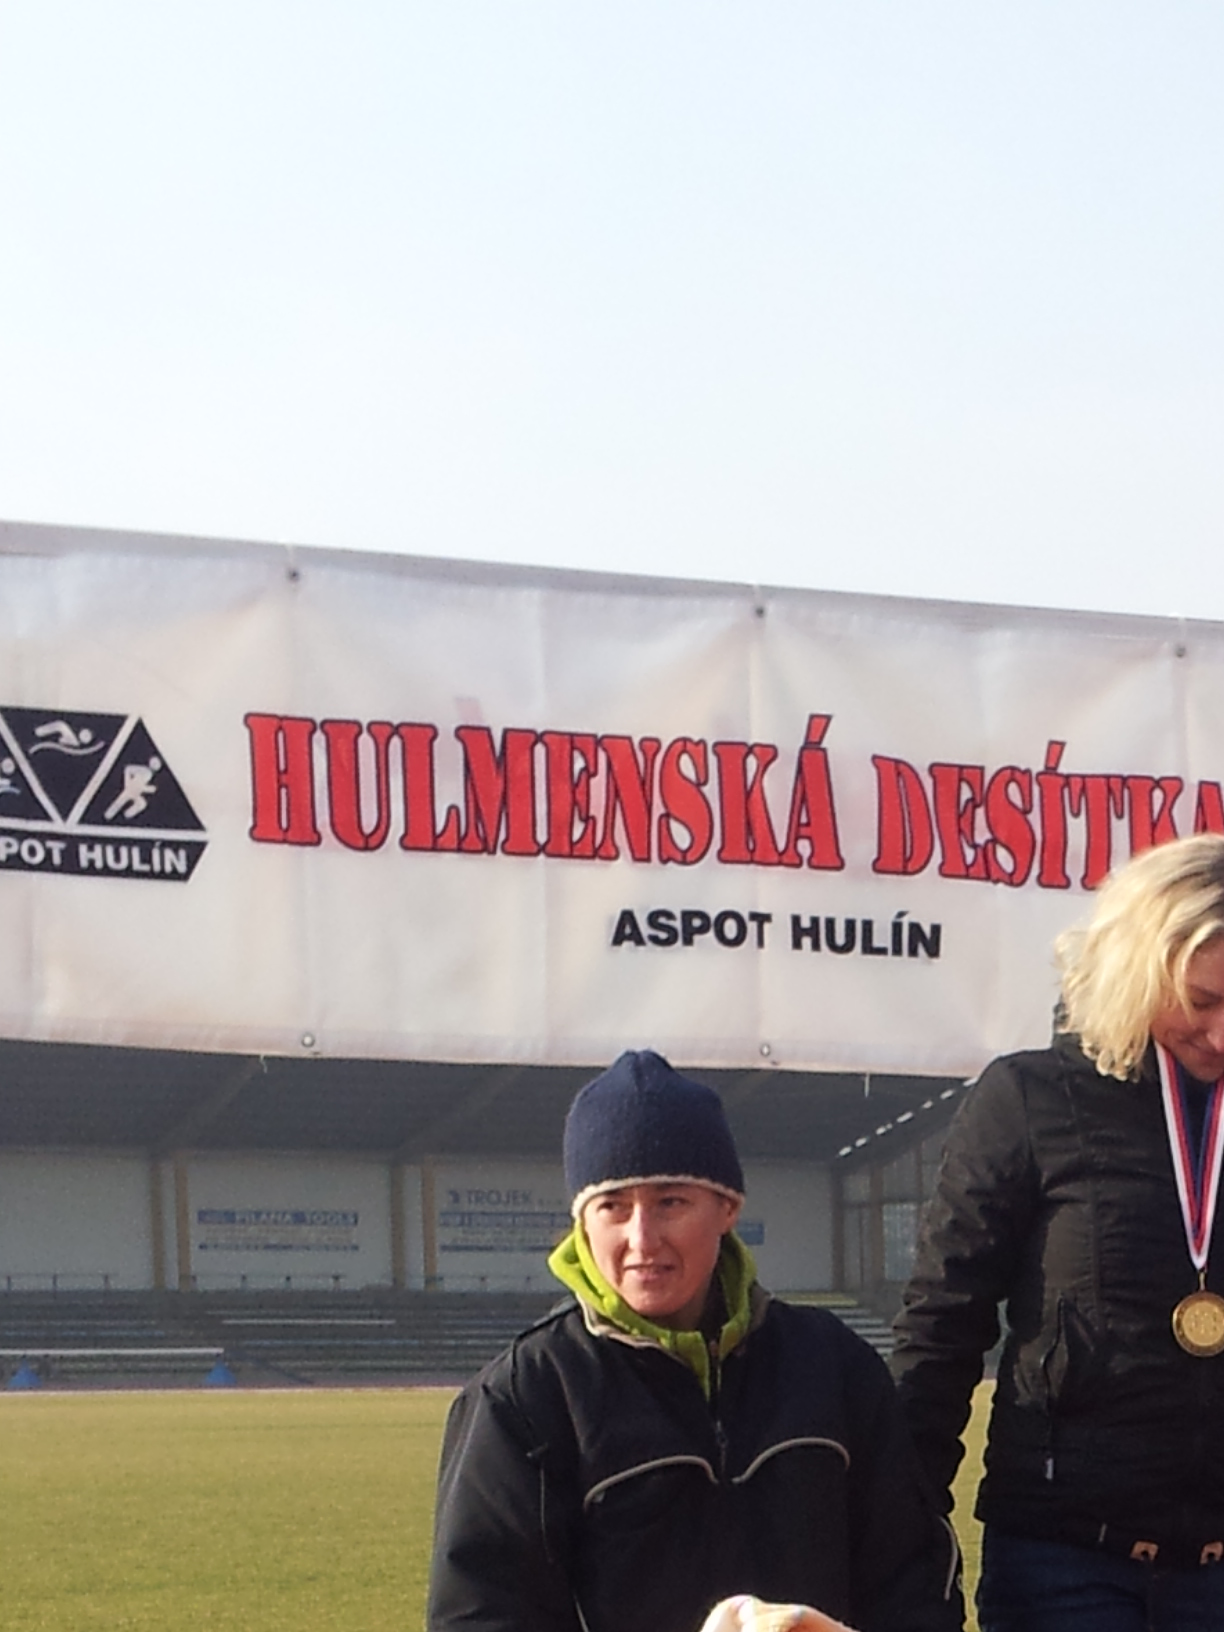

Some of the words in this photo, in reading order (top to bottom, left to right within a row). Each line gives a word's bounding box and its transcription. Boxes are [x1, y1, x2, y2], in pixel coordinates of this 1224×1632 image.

[244, 713, 845, 871] HULMENSKÁ
[0, 836, 66, 866] POT
[78, 841, 188, 874] HULÍN
[611, 909, 773, 950] ASPOT
[791, 911, 941, 958] HULÍN
